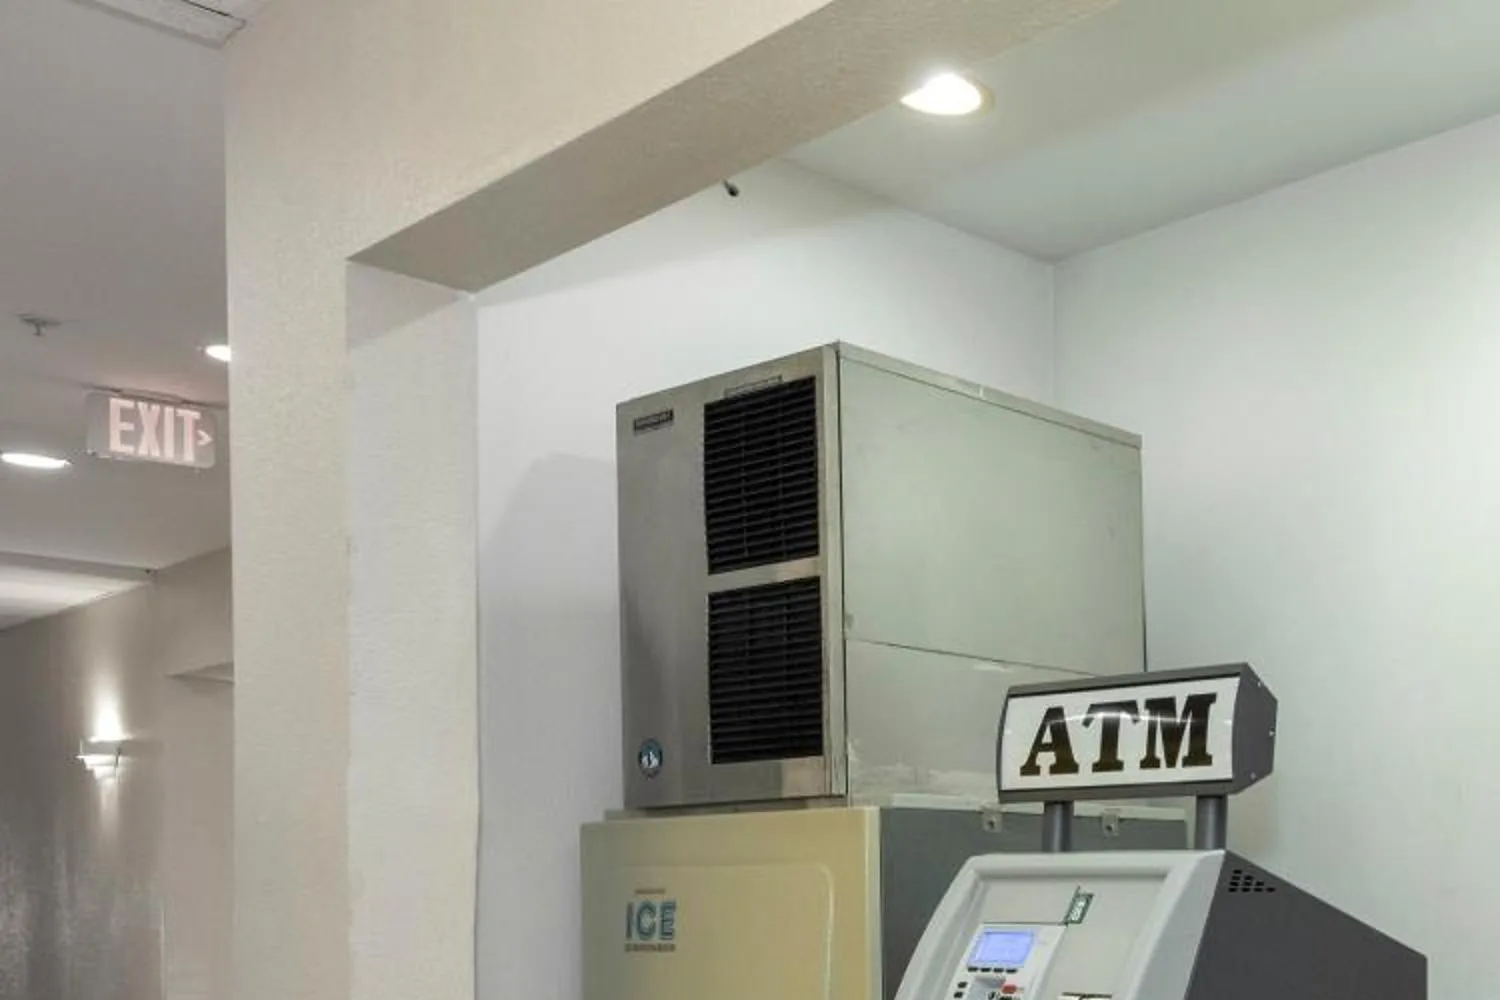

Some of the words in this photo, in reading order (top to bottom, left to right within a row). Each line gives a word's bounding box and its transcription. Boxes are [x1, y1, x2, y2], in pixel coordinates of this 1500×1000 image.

[109, 397, 201, 463] EXIT
[1020, 692, 1217, 776] ATM
[625, 900, 677, 941] ICE
